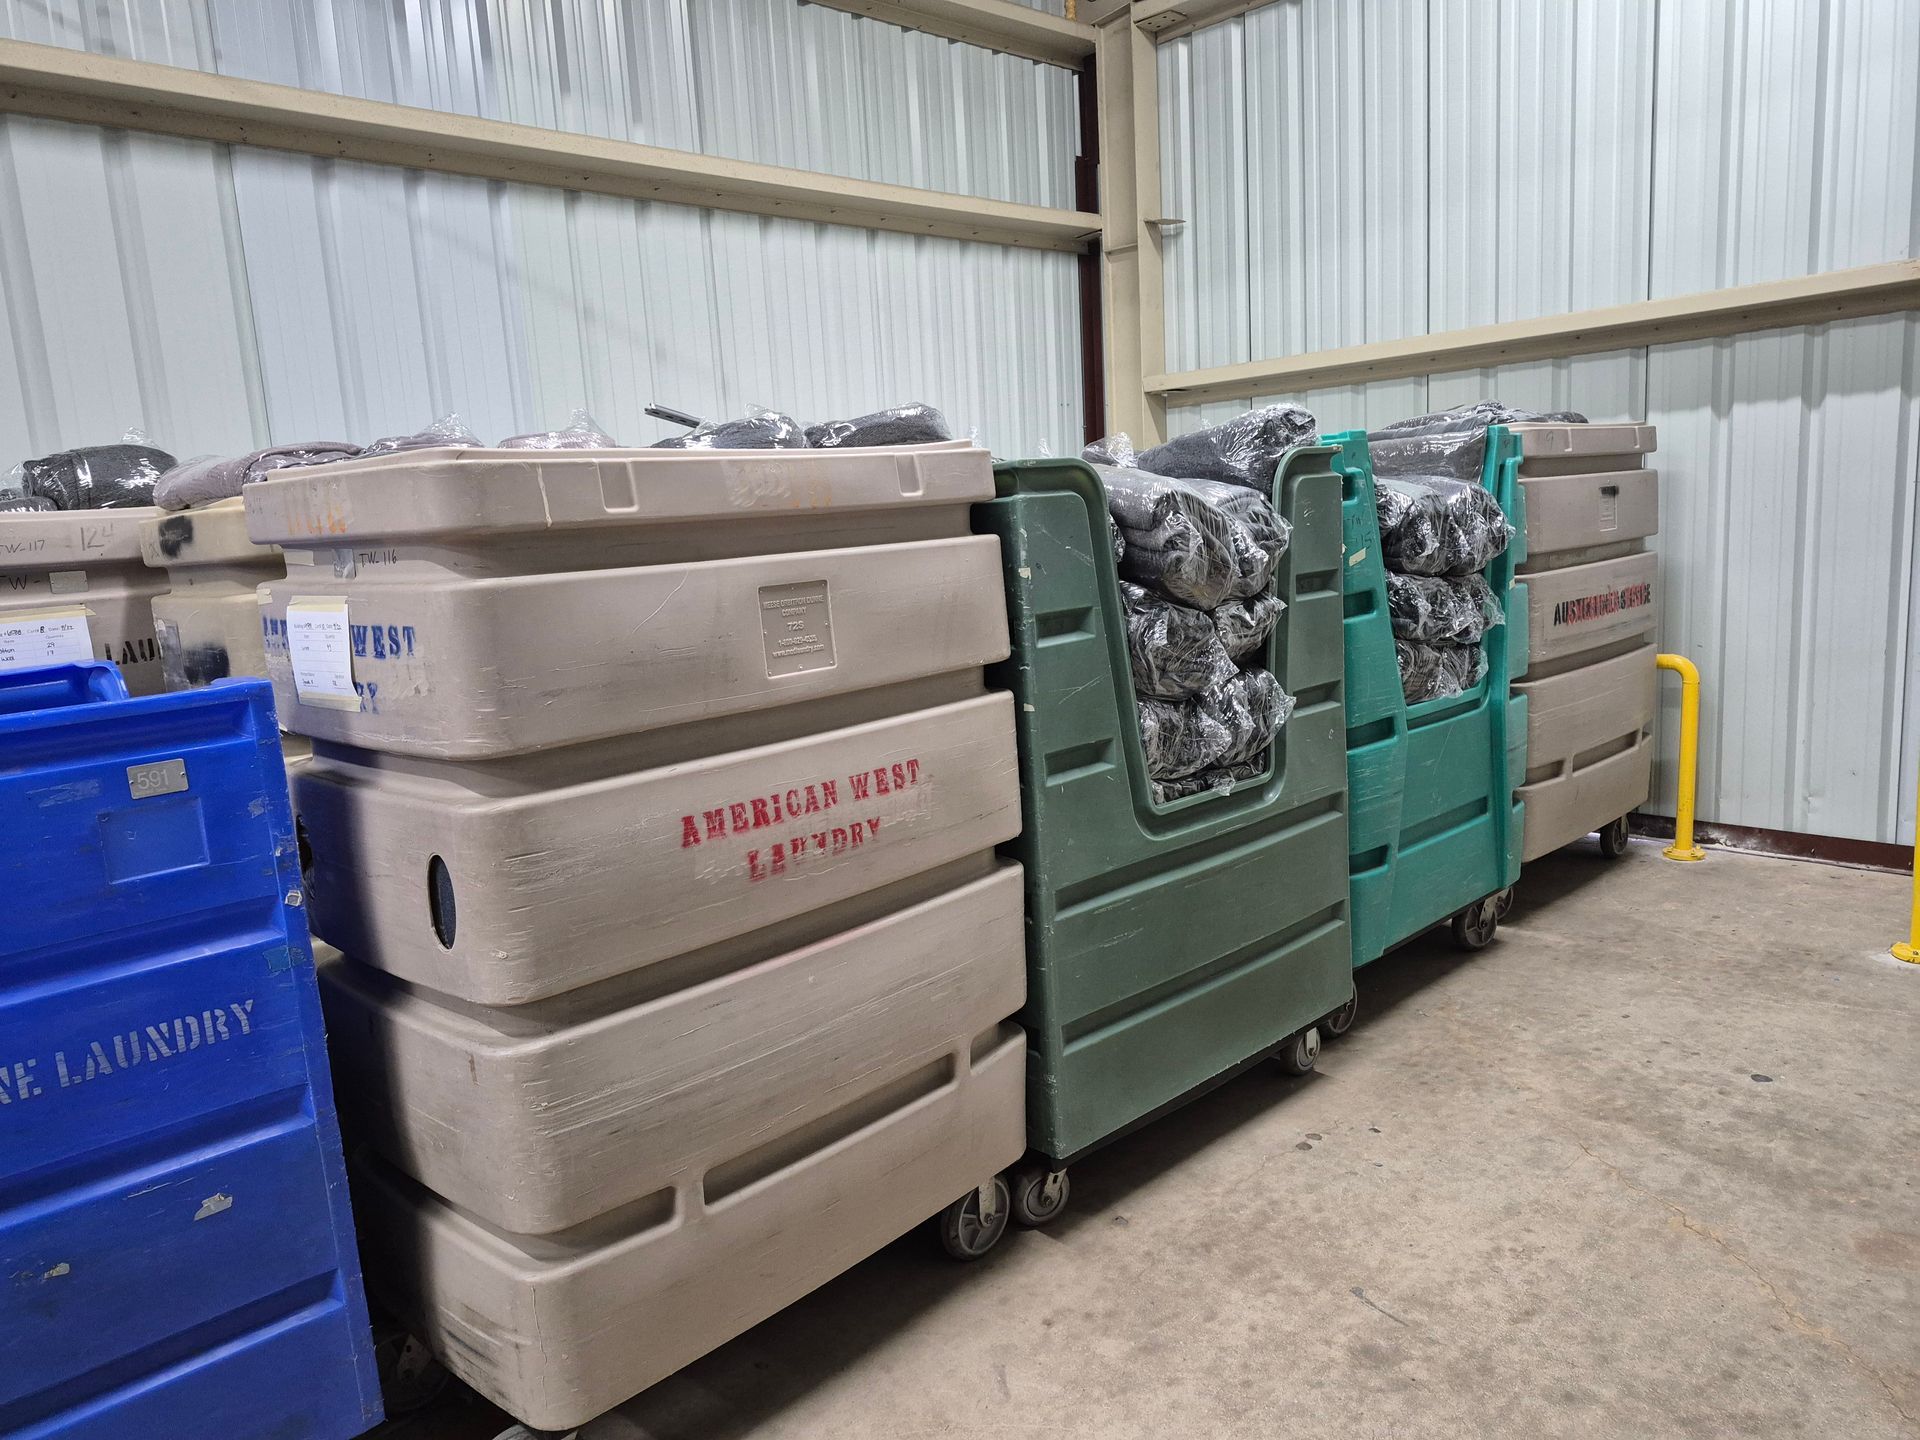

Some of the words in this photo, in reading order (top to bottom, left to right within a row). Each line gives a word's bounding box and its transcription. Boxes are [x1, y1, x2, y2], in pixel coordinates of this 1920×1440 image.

[104, 637, 162, 666] LAU
[350, 624, 417, 660] WEST
[136, 769, 169, 790] 591
[681, 780, 839, 848] AMERICAN
[849, 759, 921, 800] WEST
[747, 816, 881, 881] LAUNDRY
[54, 998, 255, 1088] LAUNDRY
